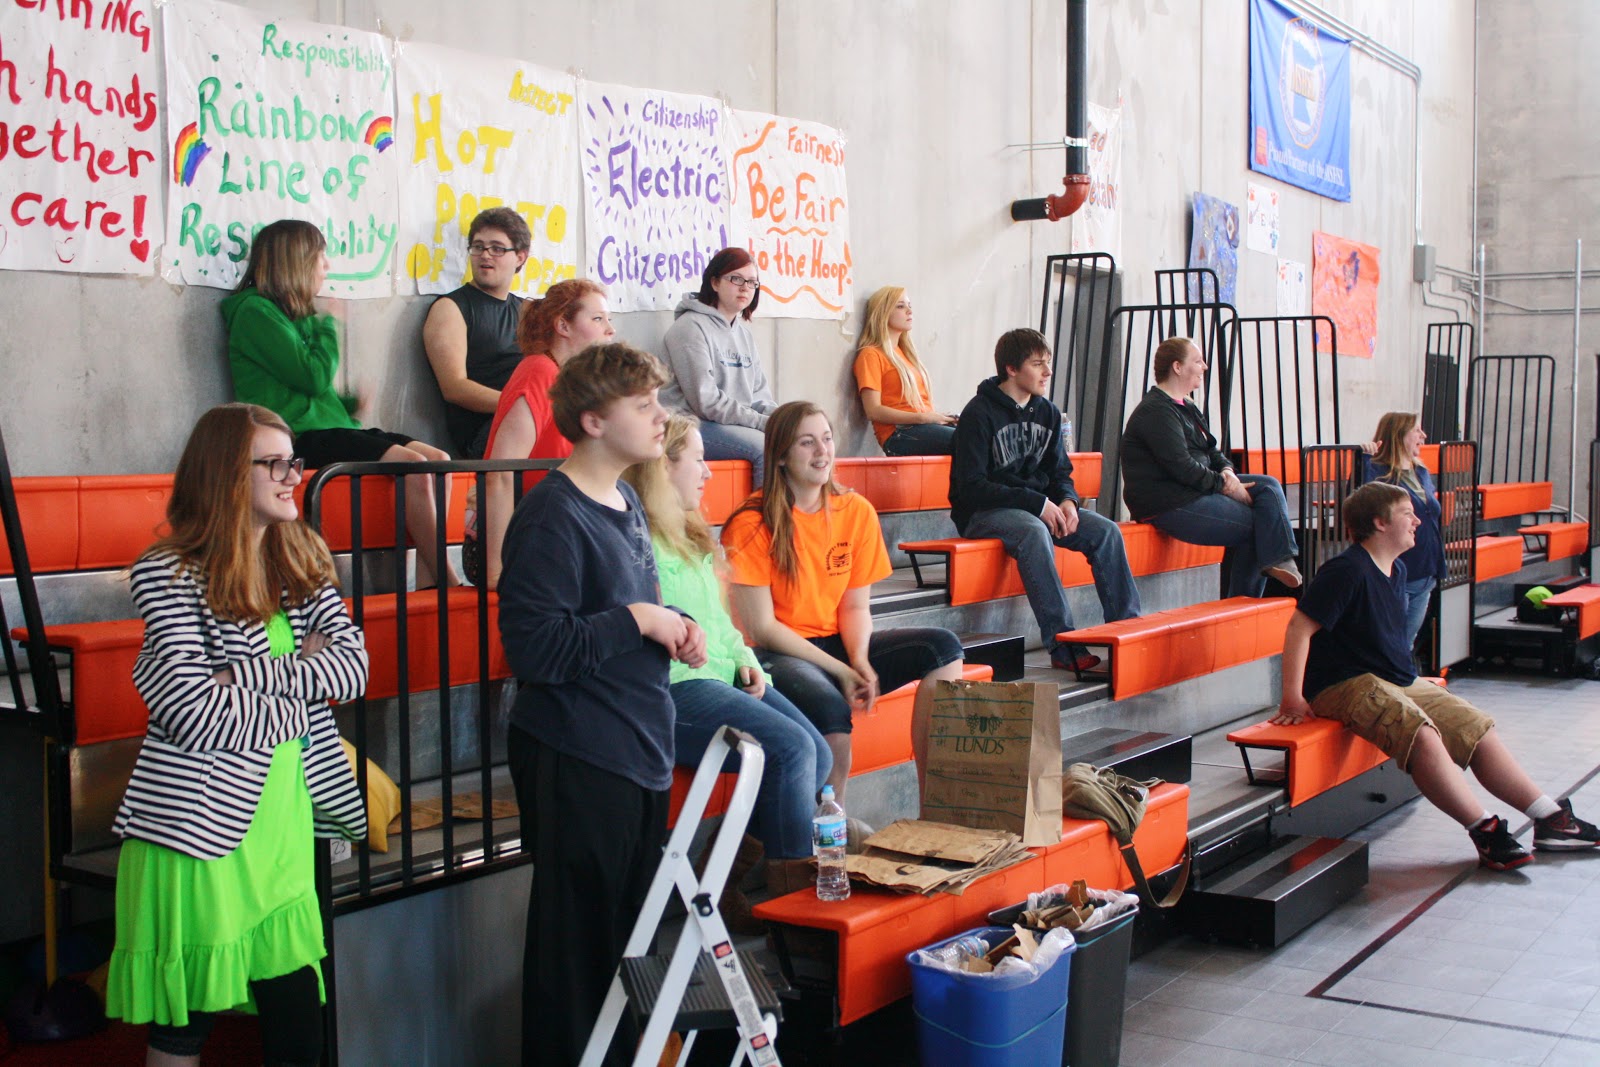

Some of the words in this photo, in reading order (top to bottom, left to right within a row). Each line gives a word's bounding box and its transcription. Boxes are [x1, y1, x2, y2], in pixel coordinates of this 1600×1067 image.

[45, 43, 157, 131] hands
[198, 77, 375, 143] Rainbow
[642, 97, 718, 137] Citizenship
[787, 125, 844, 167] Fairness
[218, 151, 311, 204] Line
[322, 154, 369, 201] of
[607, 140, 721, 210] Electric
[746, 161, 787, 223] Be
[794, 172, 845, 223] Fair
[10, 191, 147, 238] care!
[433, 182, 567, 245] POTO
[405, 243, 448, 283] OF
[773, 238, 807, 278] the
[810, 238, 853, 297] Hoop!
[955, 735, 1006, 755] LUNDS
